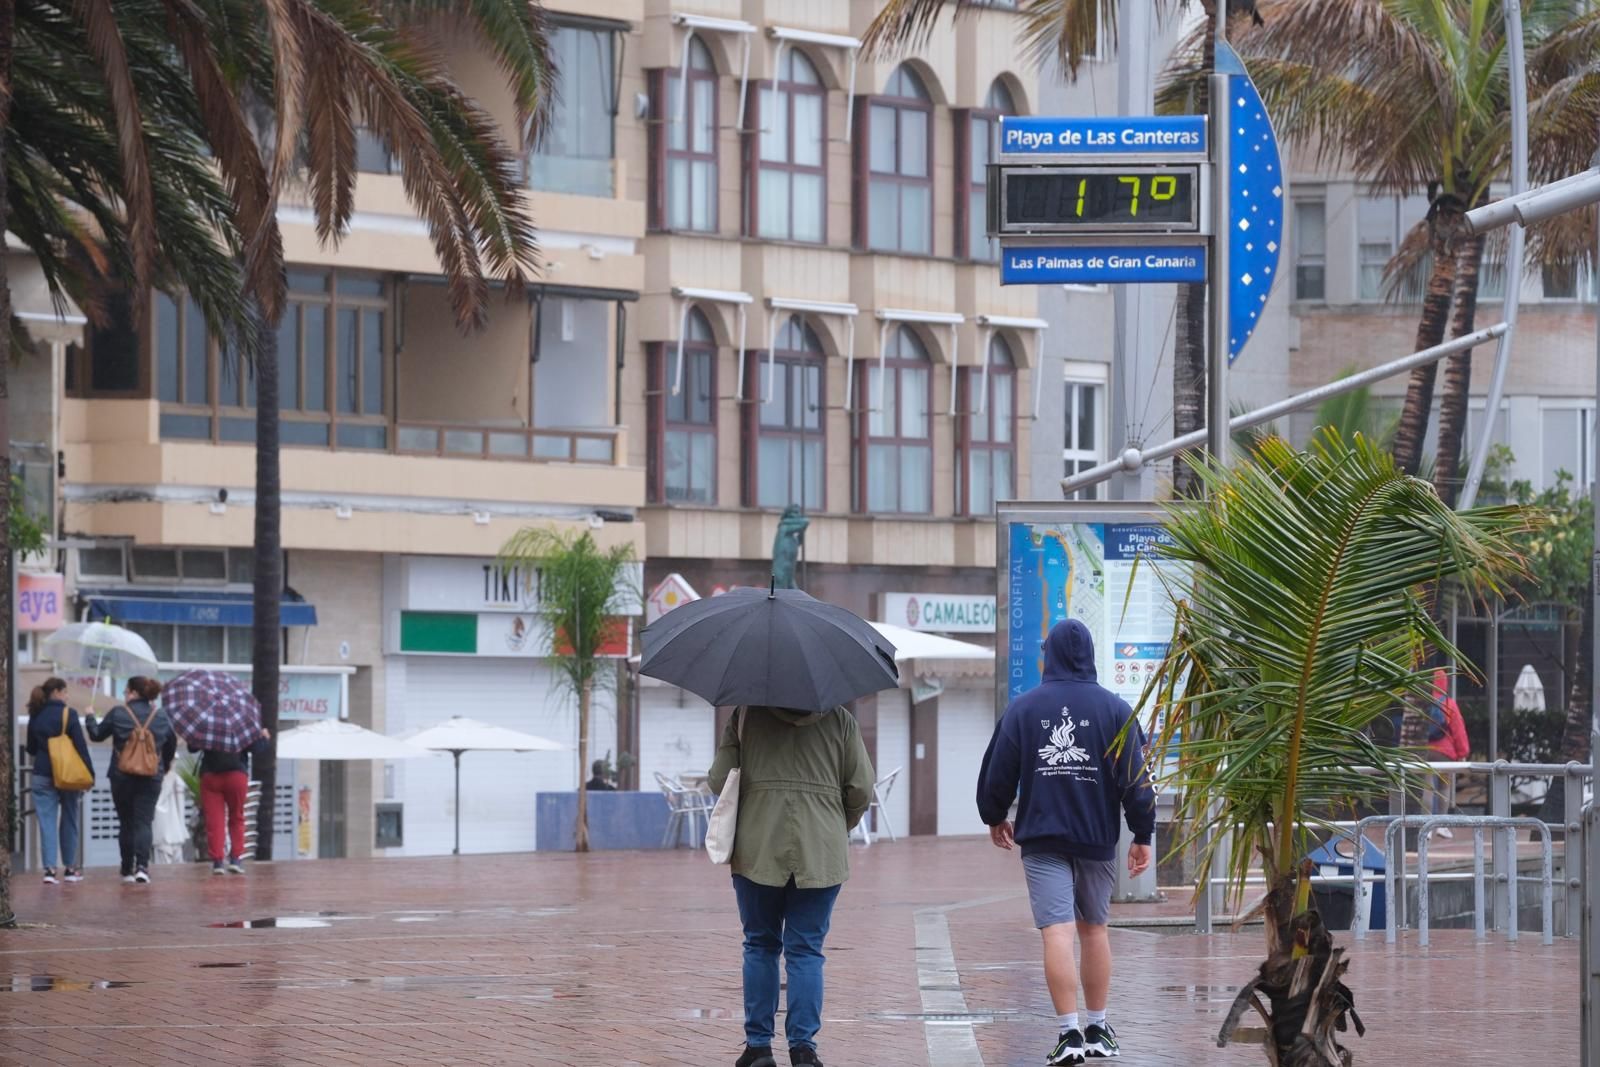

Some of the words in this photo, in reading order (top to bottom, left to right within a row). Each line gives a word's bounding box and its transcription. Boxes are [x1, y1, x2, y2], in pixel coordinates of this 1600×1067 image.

[1006, 130, 1053, 148] Playa
[1059, 130, 1081, 145] de
[1087, 130, 1116, 145] Las
[1121, 129, 1200, 145] Canteras
[1011, 256, 1034, 269] Las
[1037, 256, 1084, 269] Palmas
[1087, 256, 1105, 268] de
[1108, 256, 1142, 268] Gran
[1145, 255, 1196, 268] Canaria
[1118, 543, 1135, 552] Las
[483, 565, 518, 602] TIKI
[1012, 557, 1023, 629] CONFITAL
[1012, 635, 1023, 651] EL
[1012, 660, 1023, 678] DE
